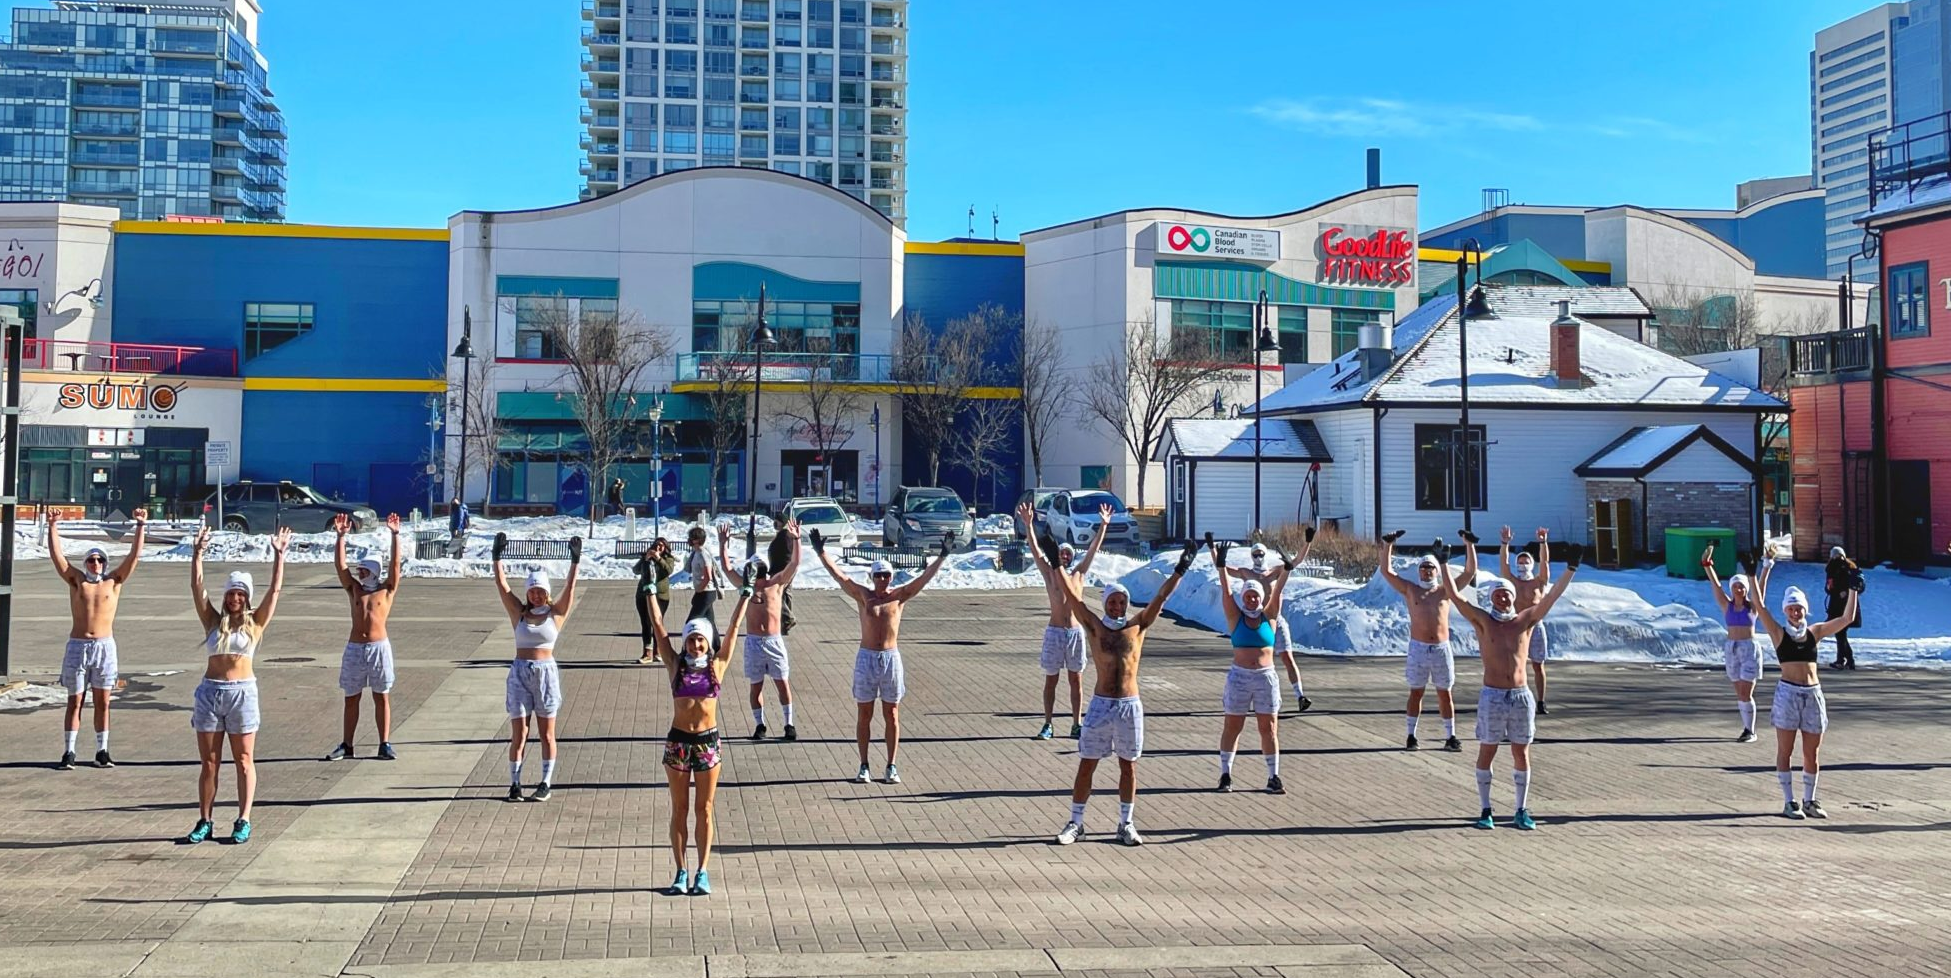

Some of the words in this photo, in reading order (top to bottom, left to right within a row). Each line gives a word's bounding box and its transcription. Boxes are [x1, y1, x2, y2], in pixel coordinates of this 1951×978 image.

[1215, 230, 1248, 239] Canadian
[1323, 227, 1412, 260] GoodLife
[1215, 247, 1245, 255] Services
[1325, 258, 1411, 283] FITNESS
[59, 383, 178, 413] SUMO
